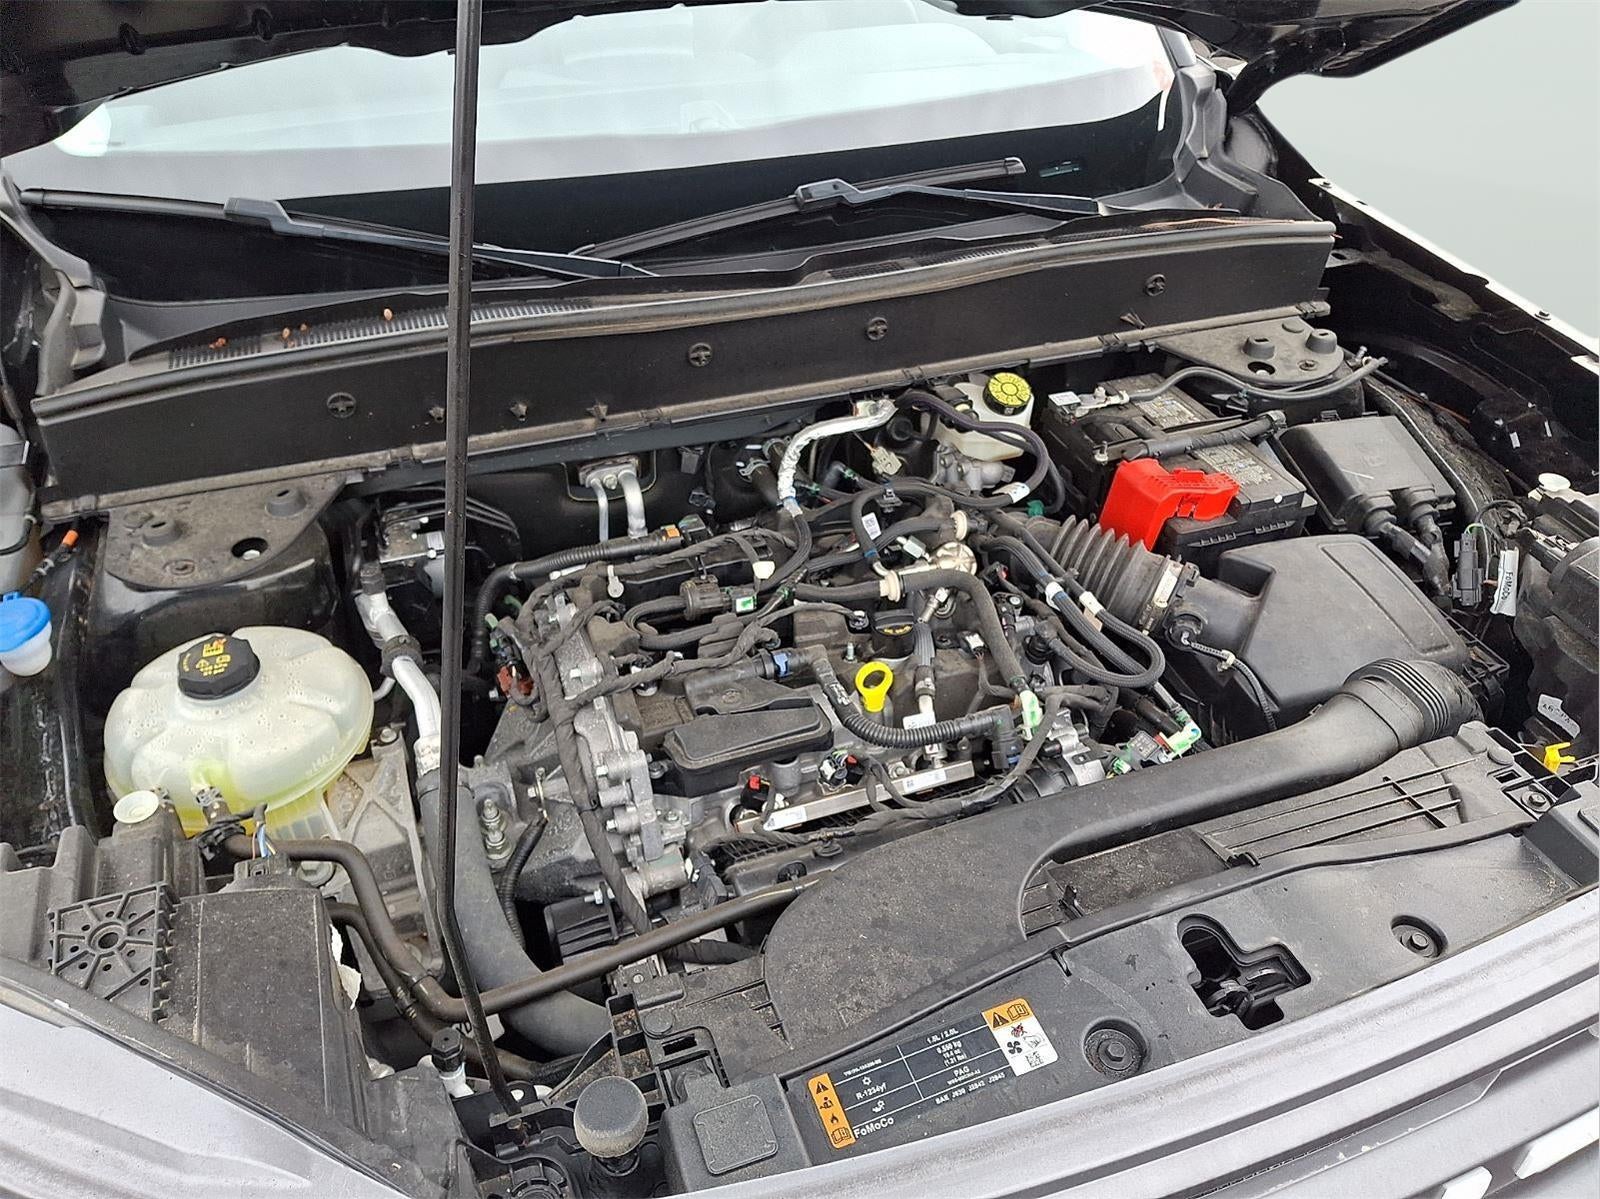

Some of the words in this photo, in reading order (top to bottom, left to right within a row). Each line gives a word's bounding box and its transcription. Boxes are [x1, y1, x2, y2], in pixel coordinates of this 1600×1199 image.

[1501, 571, 1514, 601] FoMoCo
[953, 1065, 970, 1077] PAG
[855, 1082, 887, 1100] R-1234yf
[853, 1117, 894, 1139] FoMoCo
